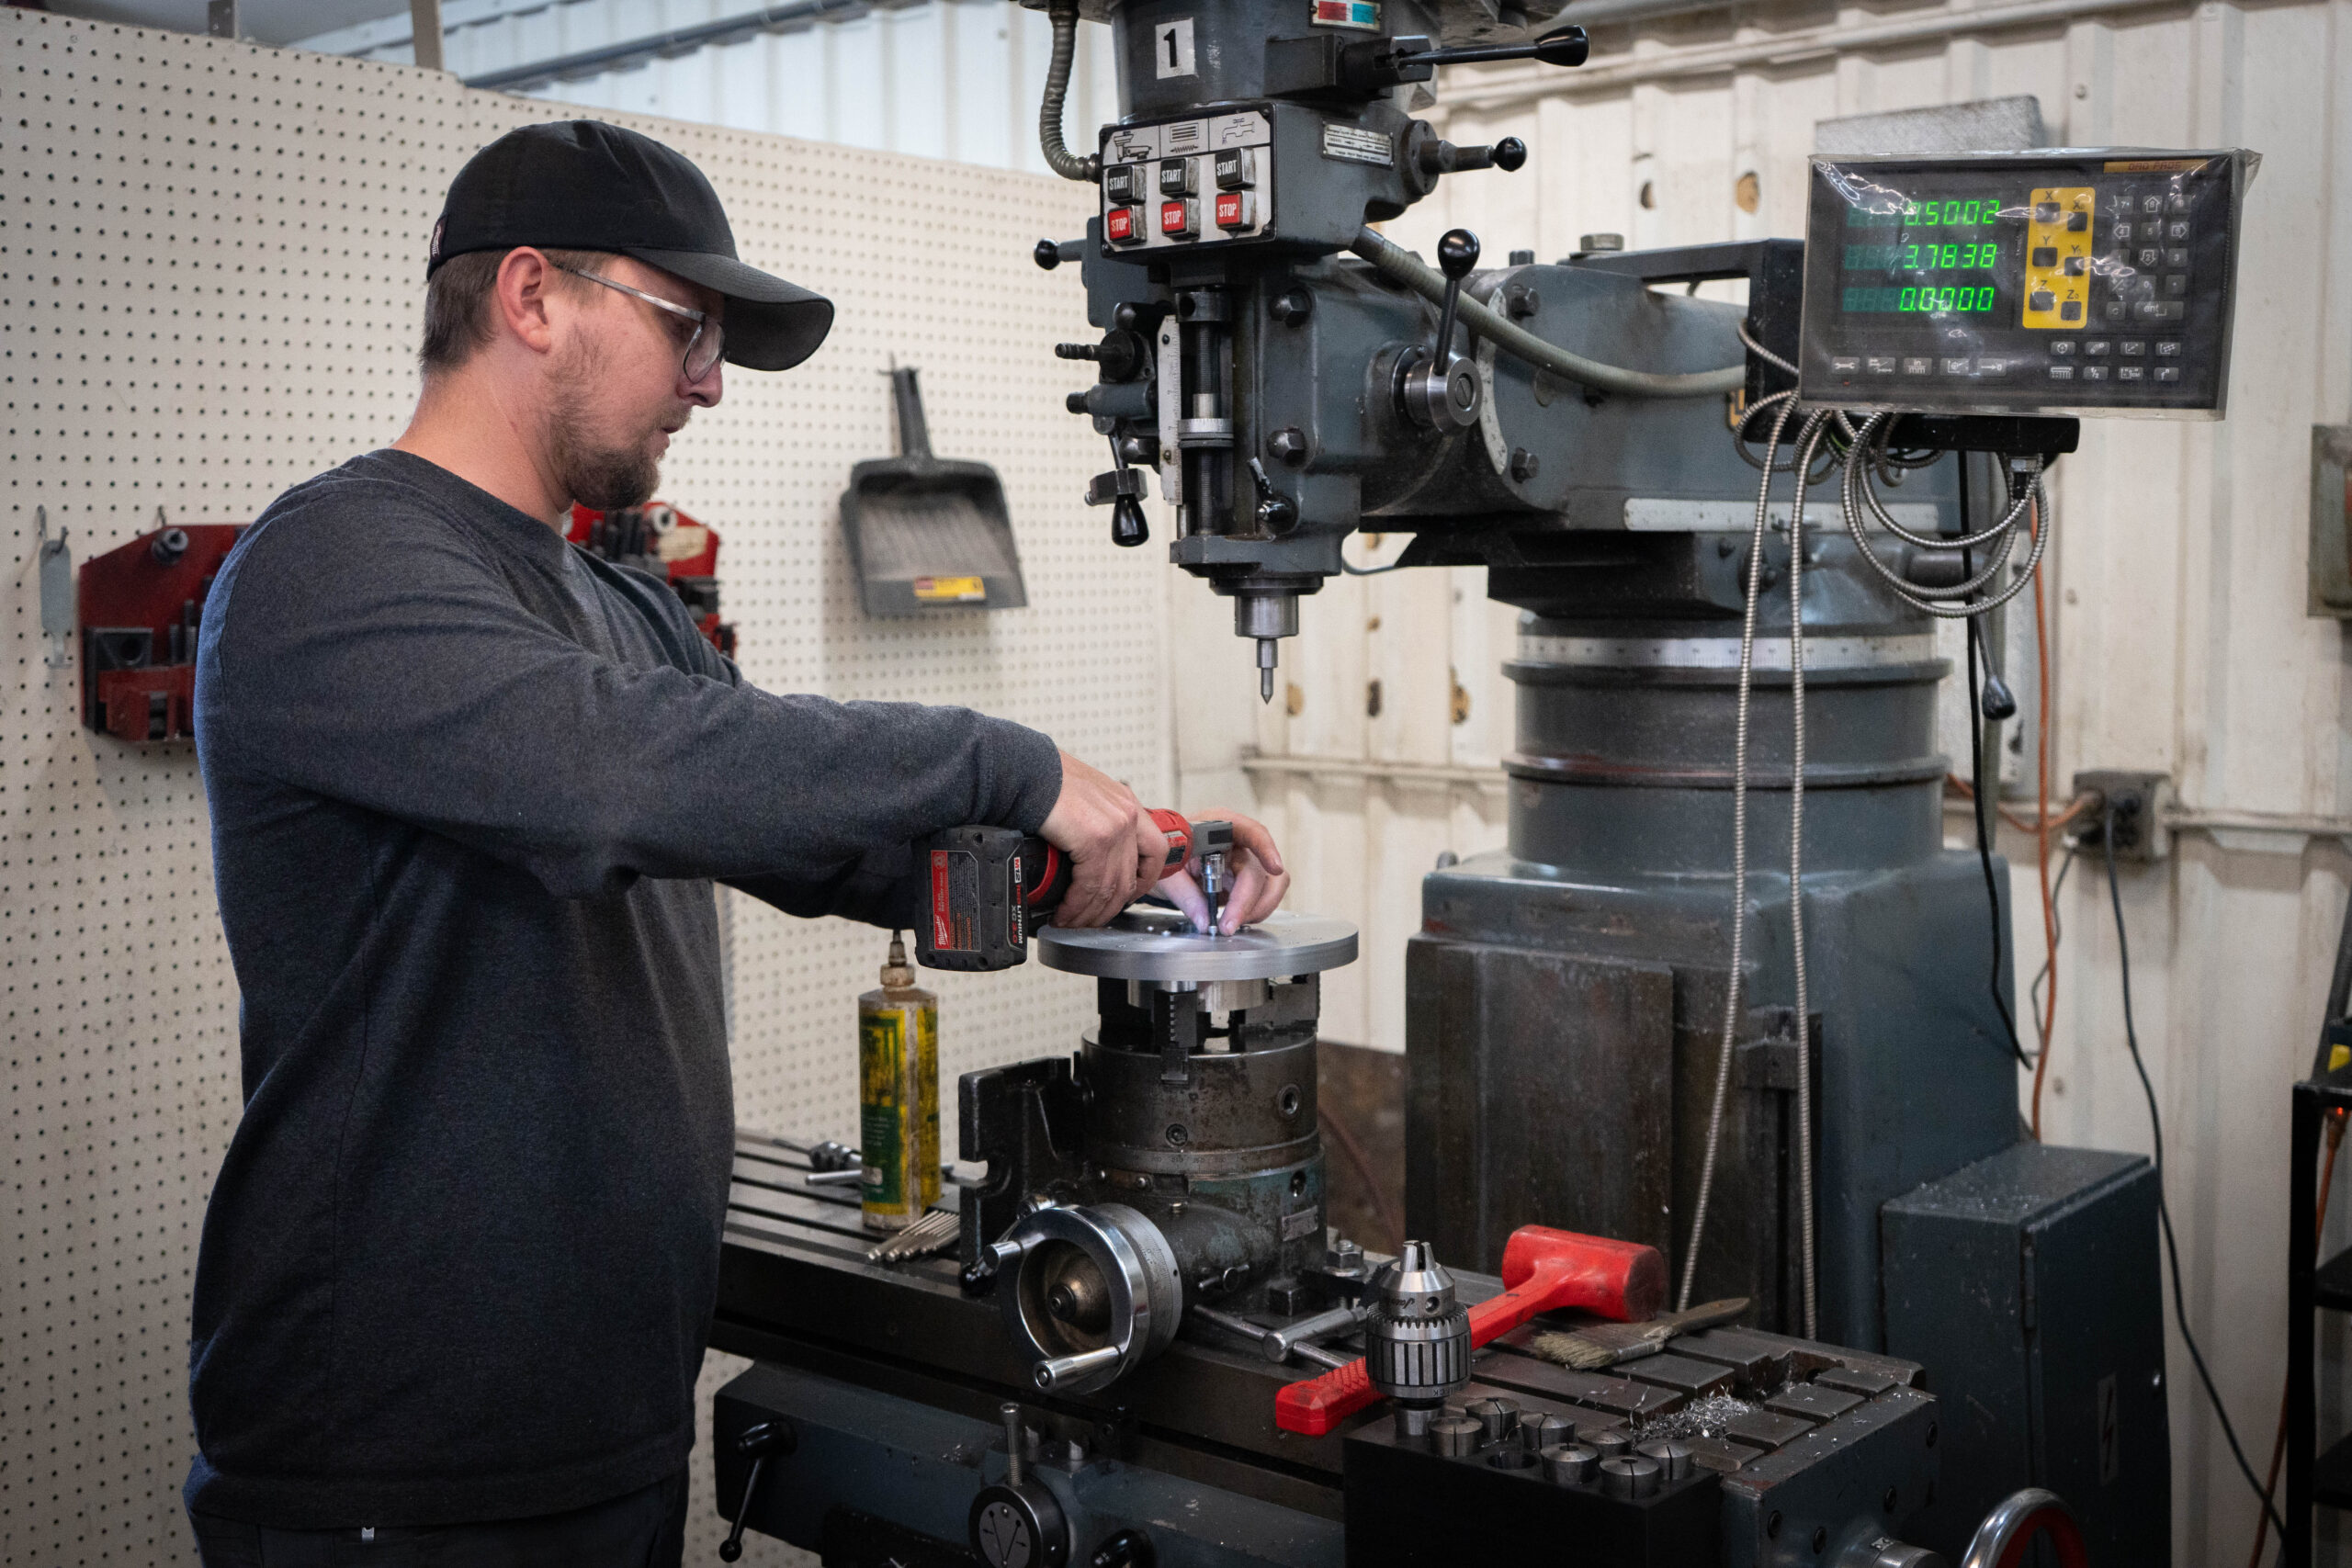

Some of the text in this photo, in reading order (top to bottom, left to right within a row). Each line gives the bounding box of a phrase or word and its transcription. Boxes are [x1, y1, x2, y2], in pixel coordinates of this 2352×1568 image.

[1163, 28, 1178, 68] 1
[1216, 159, 1238, 176] START
[1109, 175, 1129, 190] START
[1161, 168, 1182, 184] START
[2045, 190, 2053, 200] X
[1164, 209, 1182, 225] STOP
[1218, 202, 1238, 218] STOP
[1111, 217, 1128, 232] STOP
[2042, 235, 2051, 244] Y
[1904, 243, 1997, 269] 3.7838
[2174, 254, 2179, 262] 3
[2040, 279, 2048, 290] Z
[1899, 287, 1995, 311] 0.0000
